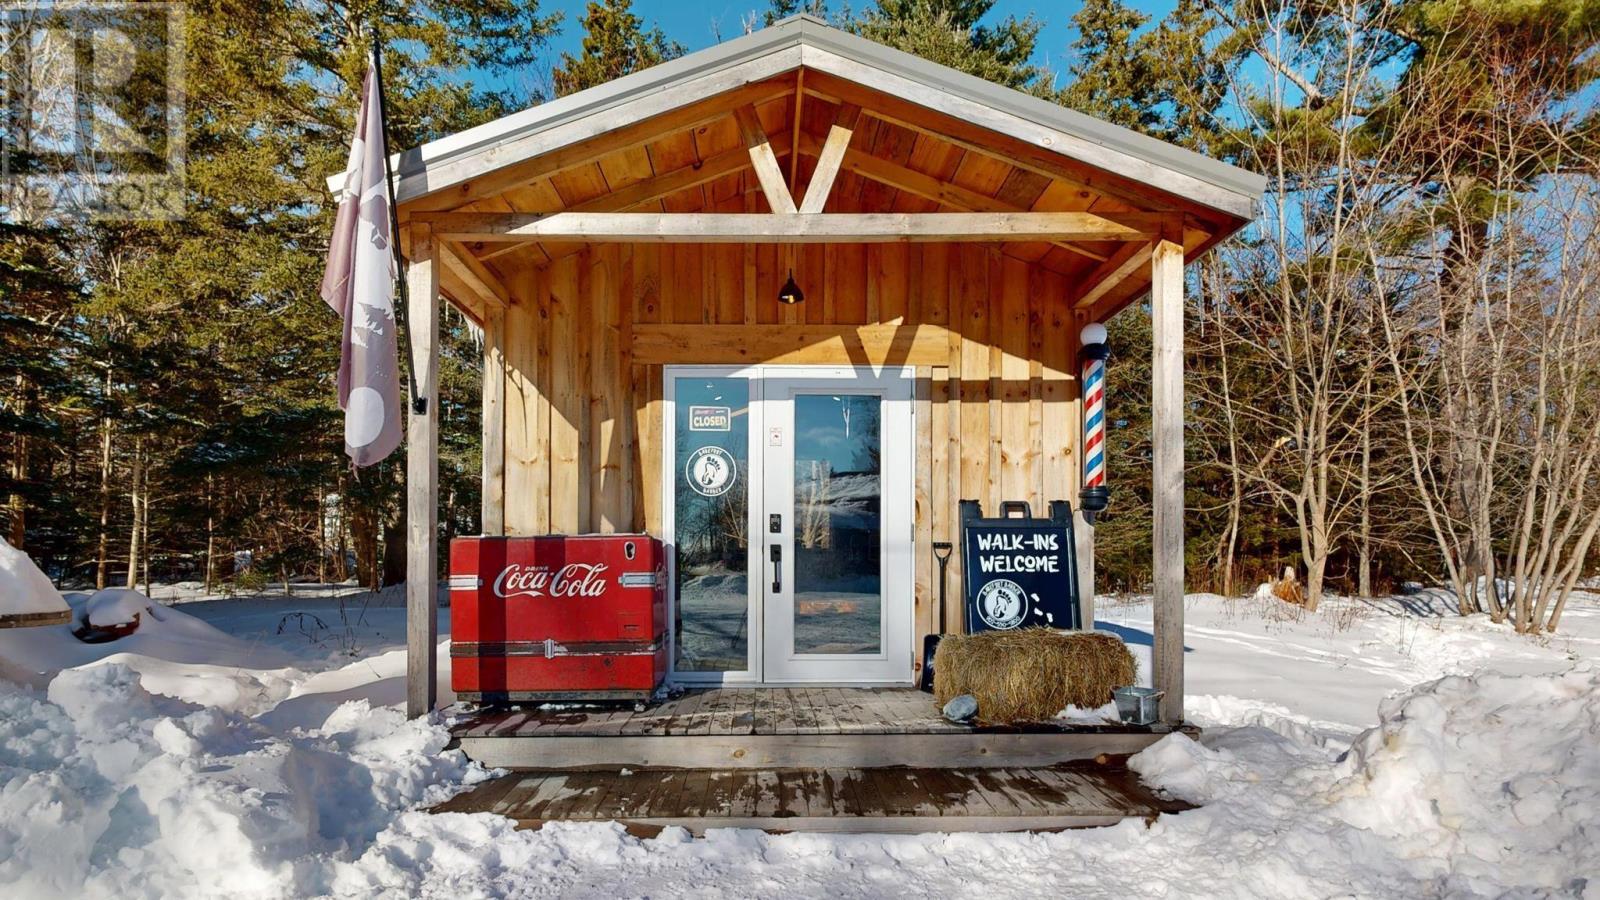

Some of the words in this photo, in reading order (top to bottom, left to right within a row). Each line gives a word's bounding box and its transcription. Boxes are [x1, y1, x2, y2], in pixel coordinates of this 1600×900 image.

[693, 415, 727, 427] CLOSED
[977, 533, 1060, 551] WALK-INS
[979, 554, 1060, 573] WELCOME
[493, 562, 609, 598] Coca-Cola
